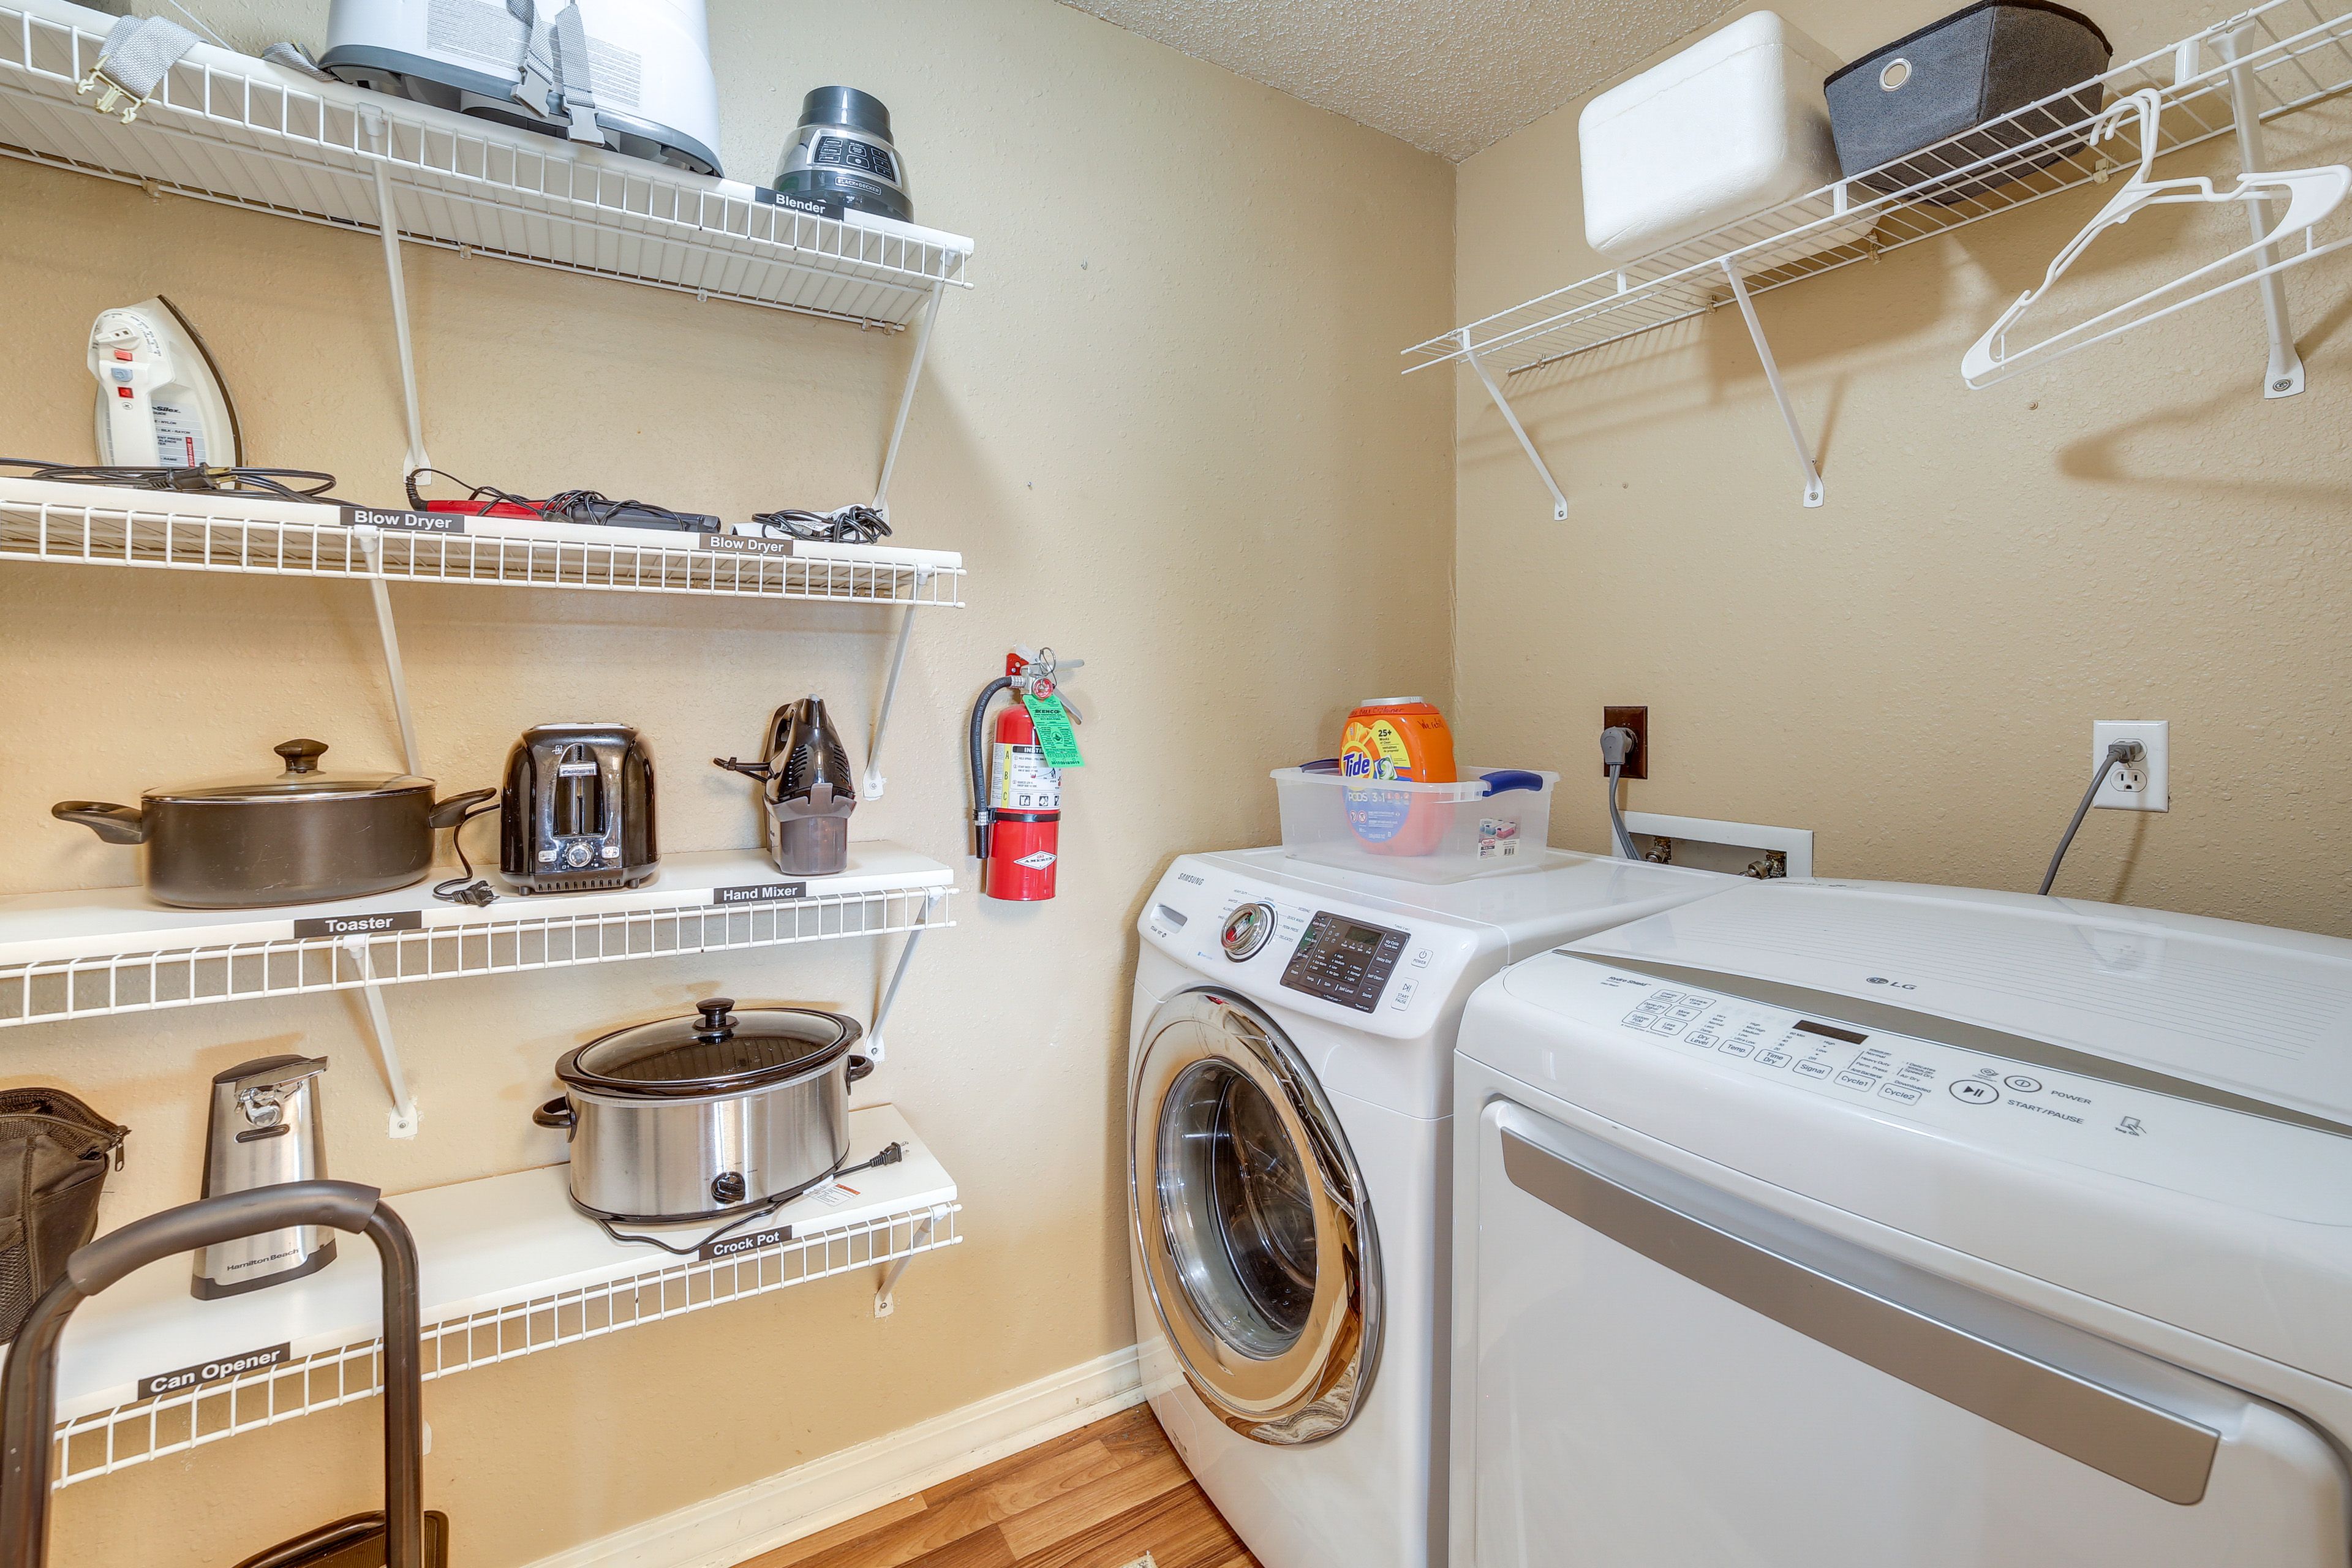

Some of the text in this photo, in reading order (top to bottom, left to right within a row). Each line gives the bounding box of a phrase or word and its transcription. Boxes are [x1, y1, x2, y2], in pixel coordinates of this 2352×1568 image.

[837, 178, 880, 194] BLACK+DECKER
[775, 194, 826, 214] Blender
[355, 510, 452, 530] Blow Dryer
[710, 536, 784, 553] Blow Dryer
[1005, 750, 1009, 760] A
[1343, 753, 1370, 777] Tide
[1005, 771, 1008, 780] B
[1003, 791, 1007, 801] C
[1348, 792, 1368, 802] PODS
[1372, 793, 1378, 802] 3
[1178, 873, 1204, 886] SAMSUNG
[723, 886, 797, 901] Hand Mixer
[325, 918, 394, 932] Toaster
[1727, 1044, 1746, 1053] Temp.
[1800, 1064, 1825, 1074] Signal
[1909, 1062, 1936, 1072] Delicates
[1841, 1075, 1868, 1087] Cycle1
[1860, 1071, 1883, 1079] Bacterial
[1894, 1079, 1931, 1093] Downloaded
[1885, 1087, 1915, 1101] Cycle2
[2051, 1090, 2092, 1104] POWER
[2007, 1099, 2084, 1124] START/PAUSE
[714, 1231, 780, 1256] Crock Pot
[227, 1248, 300, 1271] Hamilton Beach
[149, 1349, 281, 1393] Can Opener
